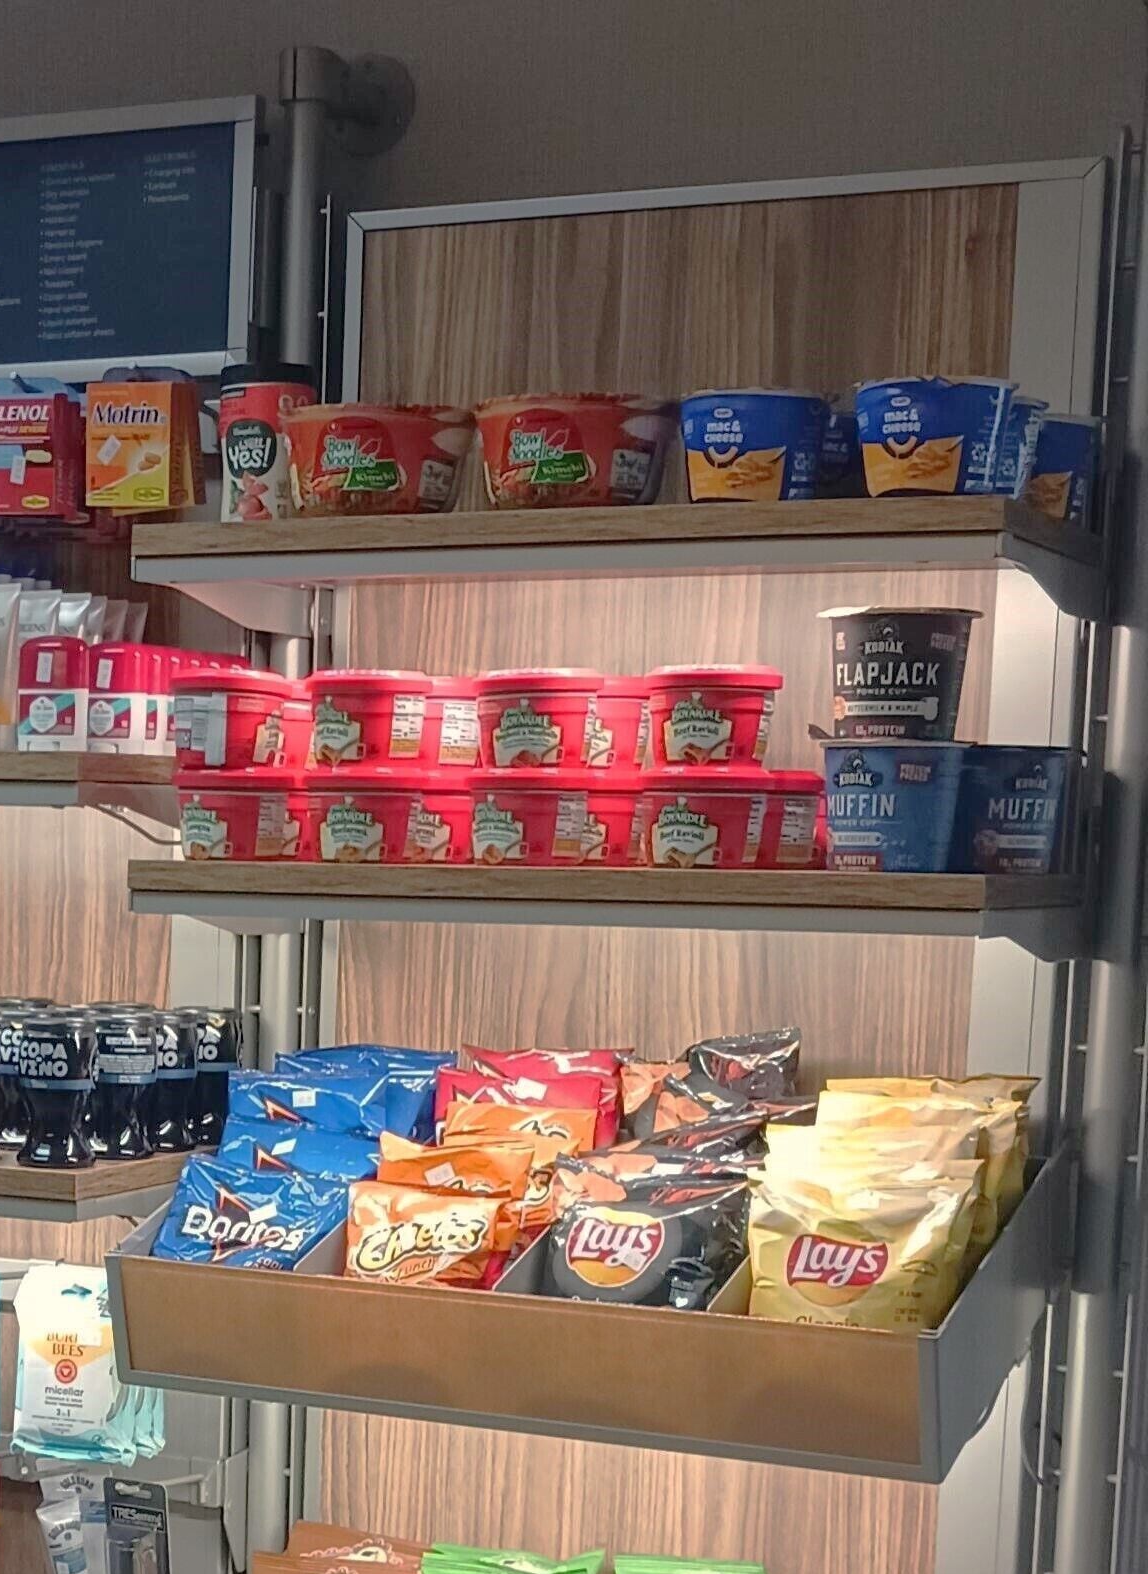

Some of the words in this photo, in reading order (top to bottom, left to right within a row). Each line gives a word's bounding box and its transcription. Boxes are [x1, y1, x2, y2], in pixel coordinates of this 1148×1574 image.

[92, 402, 158, 426] Motrin
[883, 410, 909, 422] mac
[881, 421, 921, 434] cheese
[227, 436, 271, 470] Yes!
[864, 639, 907, 655] KODIAK
[836, 660, 941, 687] FLAPJACK
[856, 687, 886, 695] POWER
[888, 687, 908, 695] CUP
[674, 725, 691, 737] Beef
[692, 723, 720, 737] Ravioli
[868, 724, 906, 735] PROTEIN
[838, 772, 874, 788] KODIAK
[1015, 777, 1049, 791] KODIAK
[828, 793, 896, 818] MUFFIN
[659, 828, 677, 840] Beef
[677, 828, 705, 841] Ravioli
[19, 1040, 69, 1060] COPA
[19, 1057, 69, 1077] VINO
[181, 1204, 308, 1252] Doritos
[355, 1216, 489, 1273] Cheetos
[791, 1233, 886, 1288] Lay's
[51, 1343, 85, 1357] BEES
[44, 1385, 84, 1397] micellar
